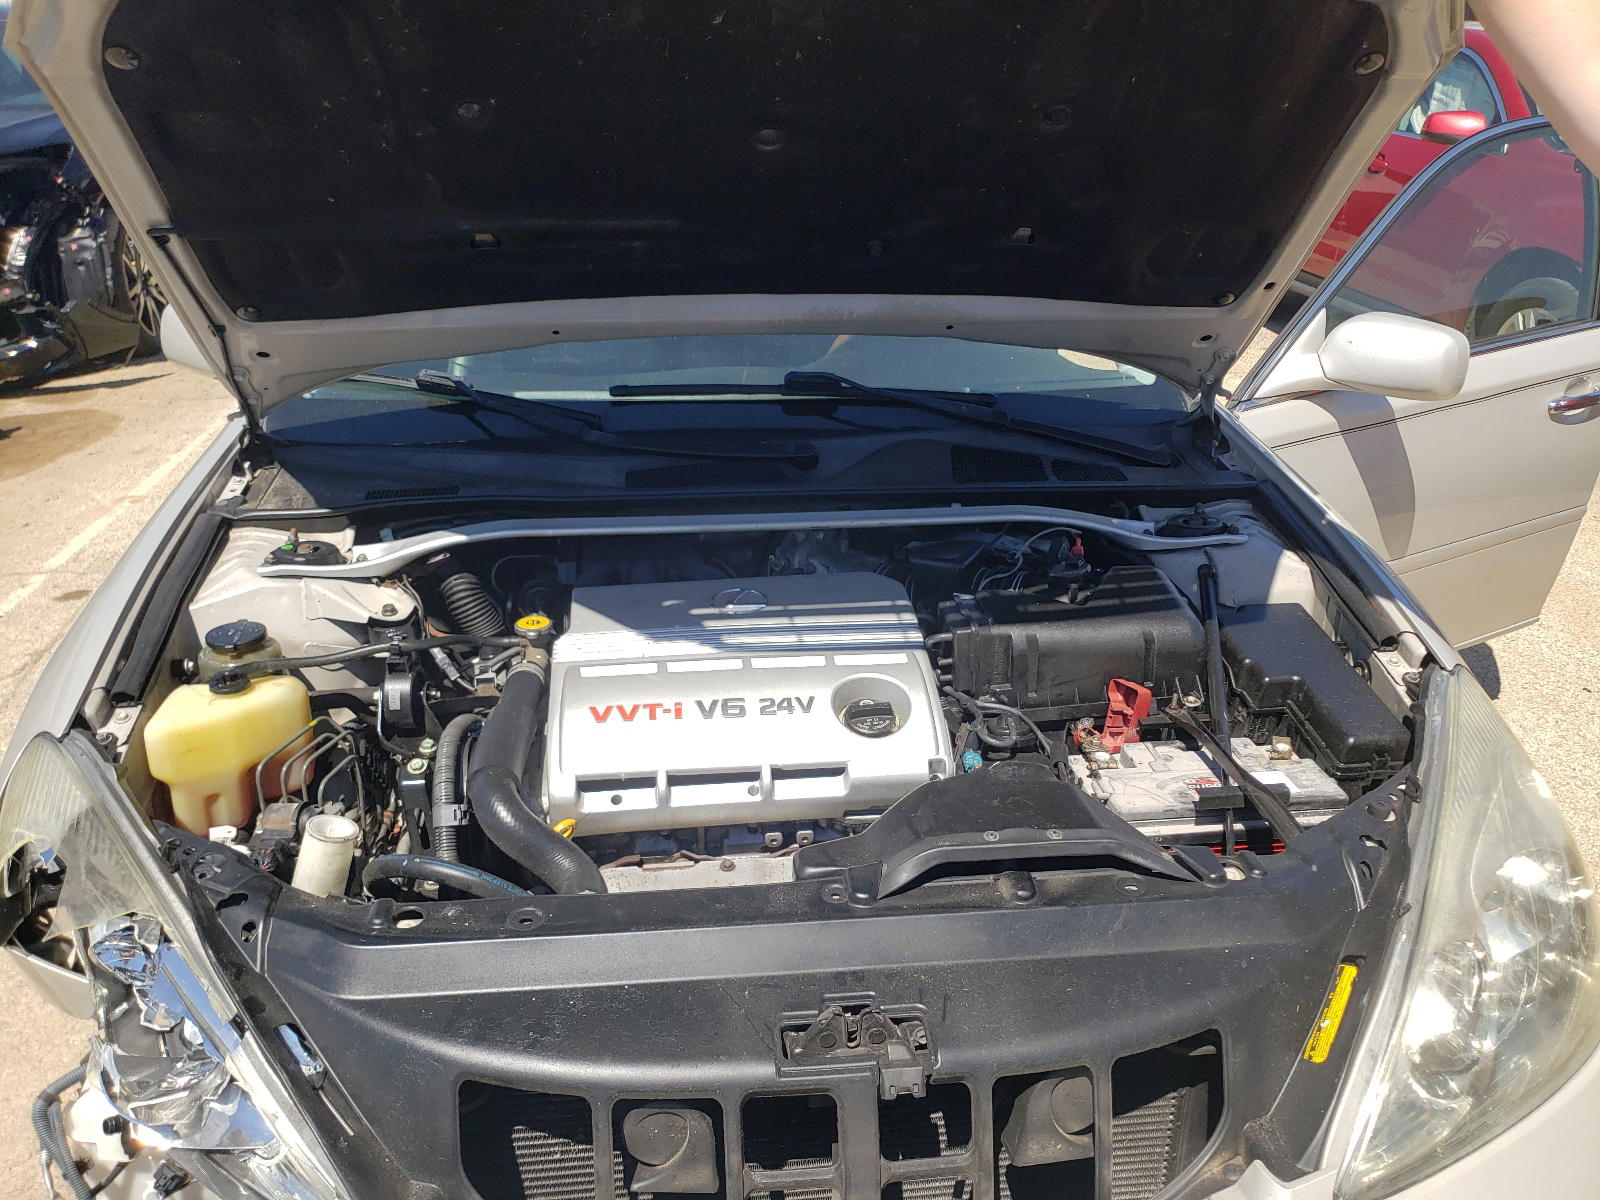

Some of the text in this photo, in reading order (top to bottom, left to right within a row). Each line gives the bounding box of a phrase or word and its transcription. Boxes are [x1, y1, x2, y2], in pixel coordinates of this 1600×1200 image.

[588, 695, 816, 723] VVT-i V6 24V
